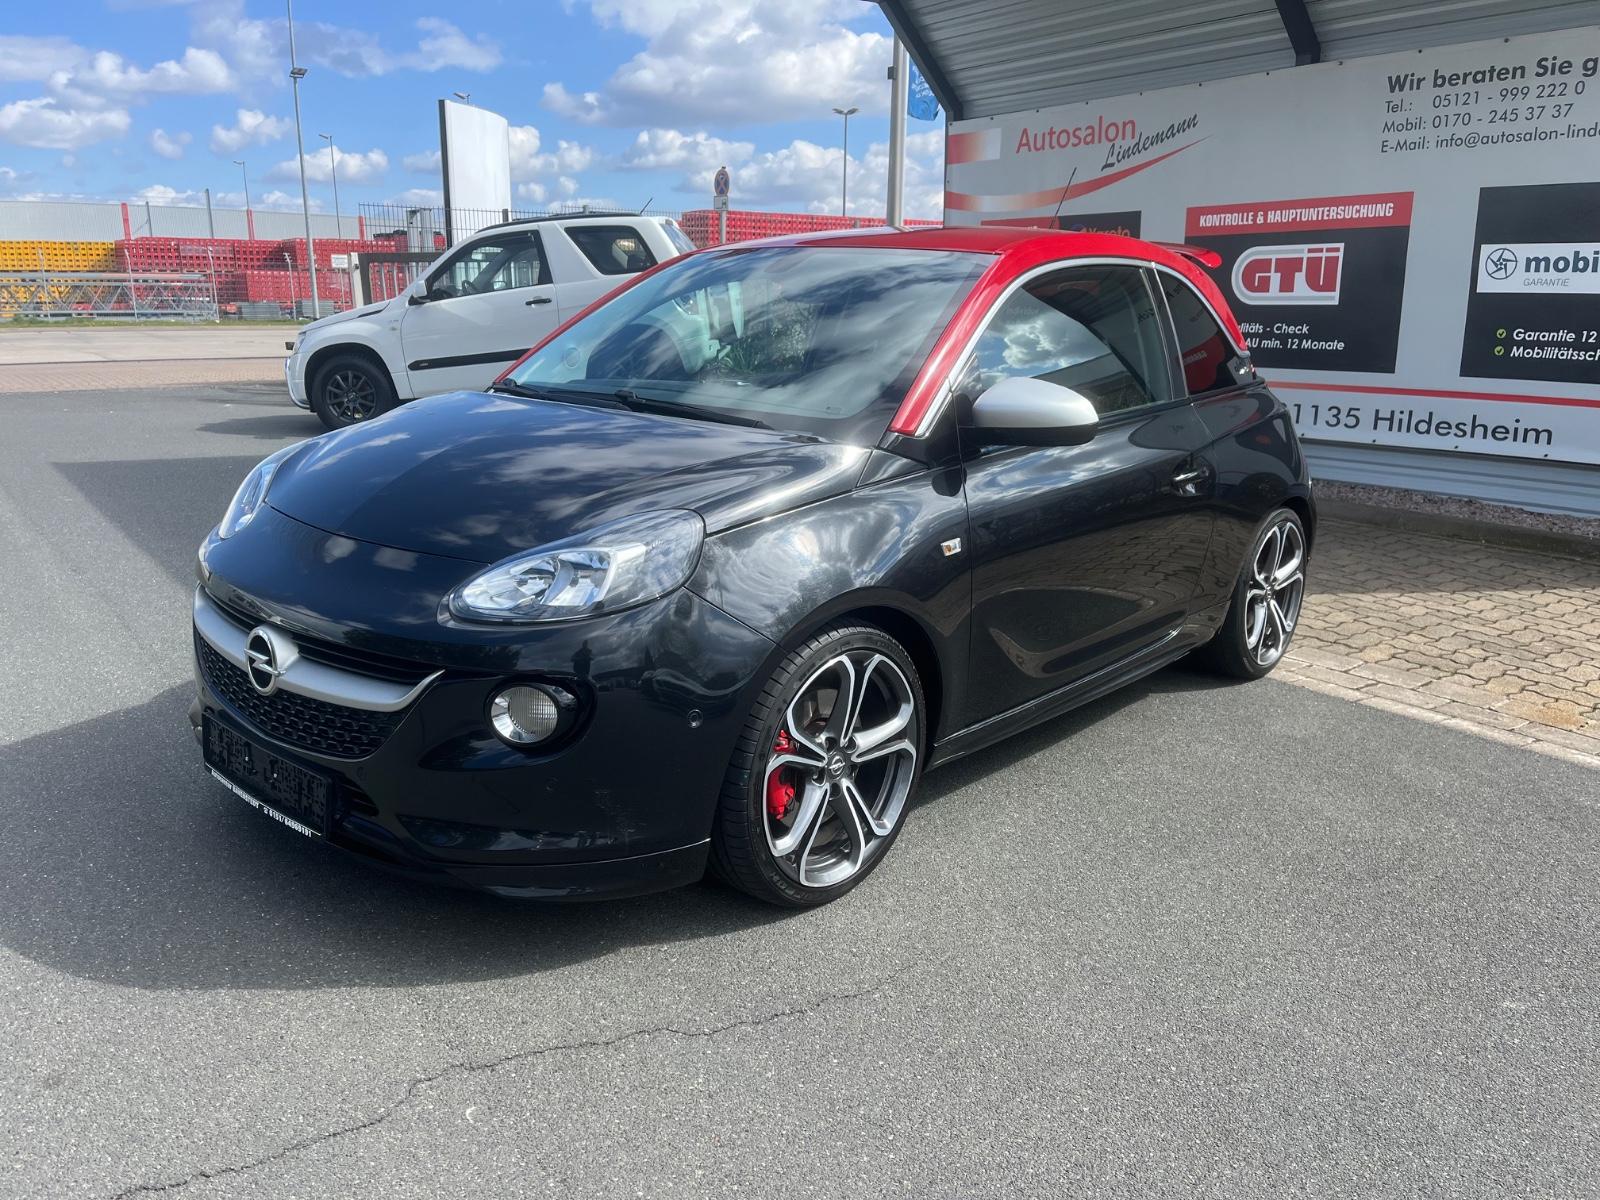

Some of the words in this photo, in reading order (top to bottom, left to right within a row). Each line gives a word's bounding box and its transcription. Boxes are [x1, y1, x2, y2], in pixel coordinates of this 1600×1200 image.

[1387, 73, 1426, 94] Wir
[1433, 64, 1526, 89] beraten
[1535, 56, 1573, 78] Sie
[1385, 100, 1413, 114] Tel.:
[1433, 91, 1480, 109] 05121
[1499, 86, 1530, 103] 999
[1535, 82, 1568, 99] 222
[1574, 80, 1586, 95] 0
[1382, 116, 1427, 133] Mobil:
[1432, 112, 1471, 129] 0170
[1487, 108, 1519, 124] 245
[1525, 105, 1546, 121] 37
[1551, 102, 1574, 118] 37
[1016, 115, 1136, 154] Autosalon
[1101, 113, 1199, 172] Lindemann
[1381, 136, 1430, 153] E-Mail:
[1435, 122, 1600, 149] info@autosalon-lind
[1199, 211, 1254, 228] KONTROLLE
[1256, 211, 1264, 224] &
[1267, 203, 1394, 223] HAUPTUNTERSUCHUNG
[1241, 247, 1341, 293] GTÜ
[1524, 250, 1600, 273] mobi
[1523, 278, 1570, 287] GARANTIE
[1238, 322, 1263, 334] litäts
[1273, 322, 1310, 335] Check
[1513, 328, 1576, 342] Garantie
[1582, 330, 1597, 343] 12
[1261, 338, 1283, 349] min.
[1287, 338, 1299, 349] 12
[1301, 338, 1345, 351] Monate
[1373, 408, 1553, 446] Hildesheim
